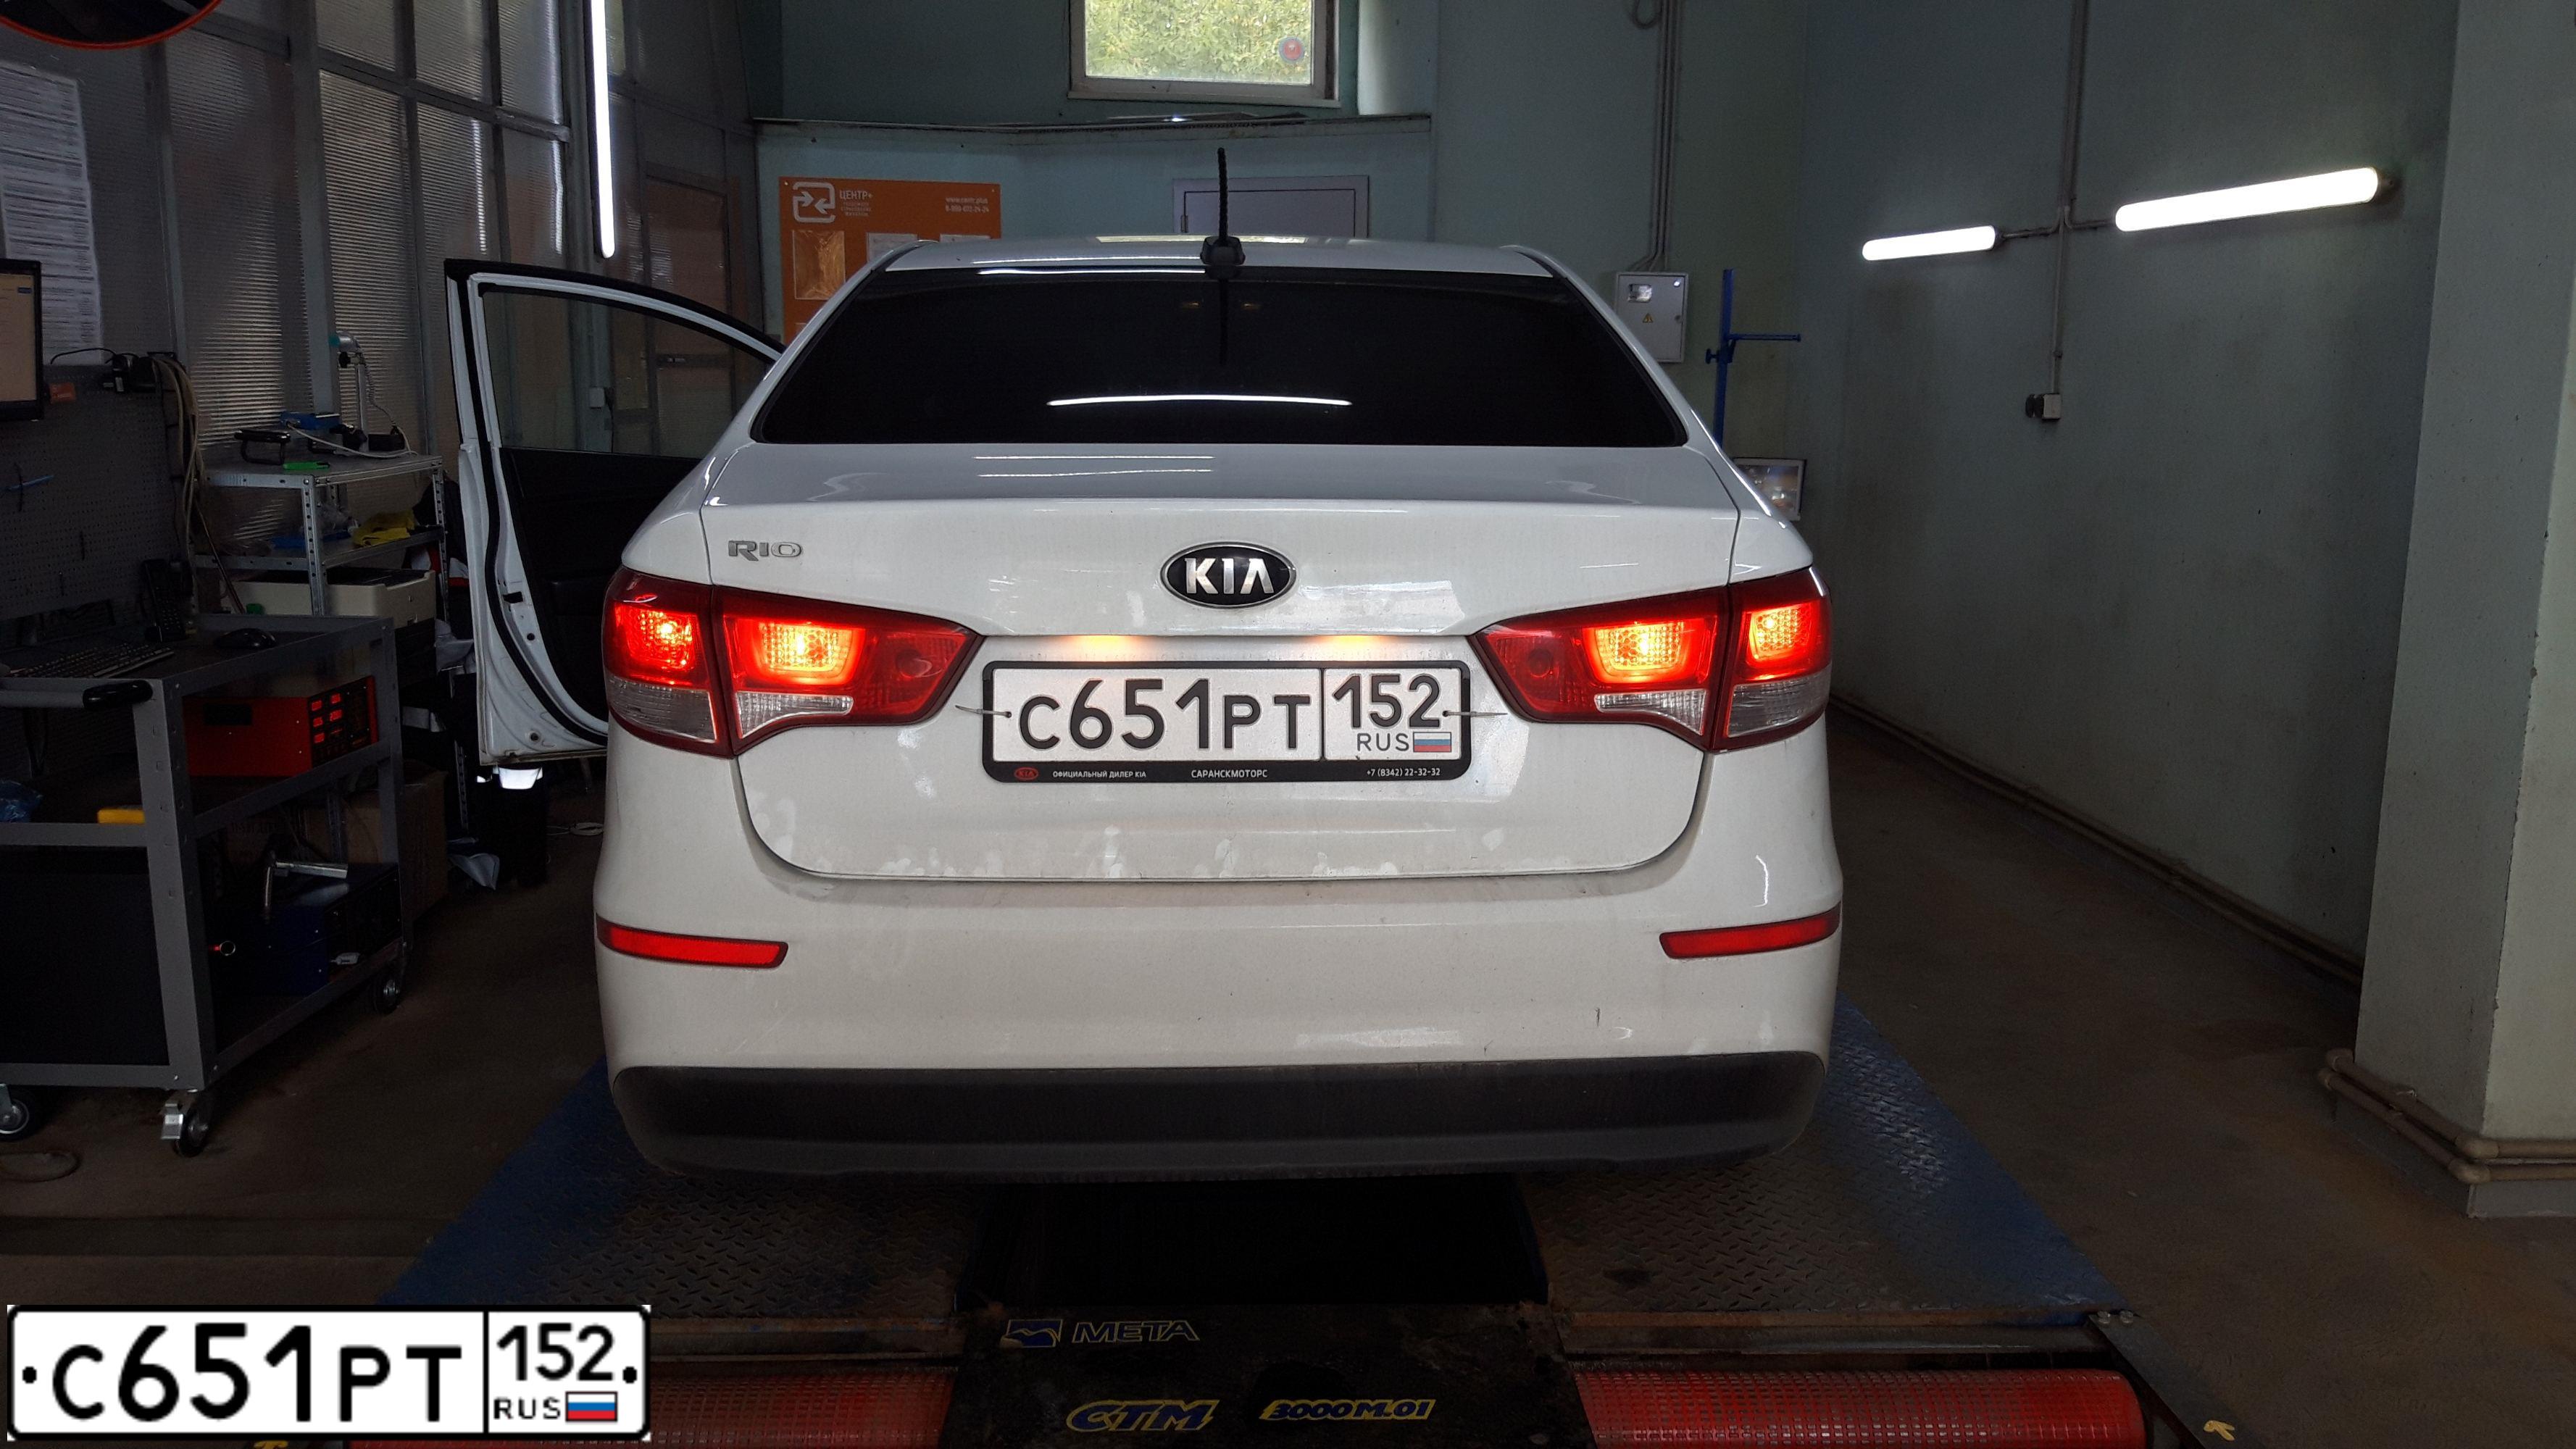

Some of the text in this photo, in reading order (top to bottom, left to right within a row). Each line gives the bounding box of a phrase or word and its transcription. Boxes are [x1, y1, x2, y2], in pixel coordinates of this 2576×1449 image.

[728, 540, 803, 561] RIO
[1183, 557, 1275, 595] KIA
[1333, 673, 1441, 729] 152
[1356, 732, 1409, 752] RUS
[1191, 769, 1268, 779] САРАНСКМОТОРС
[1367, 767, 1441, 777] +7 (8342) 22-32-32
